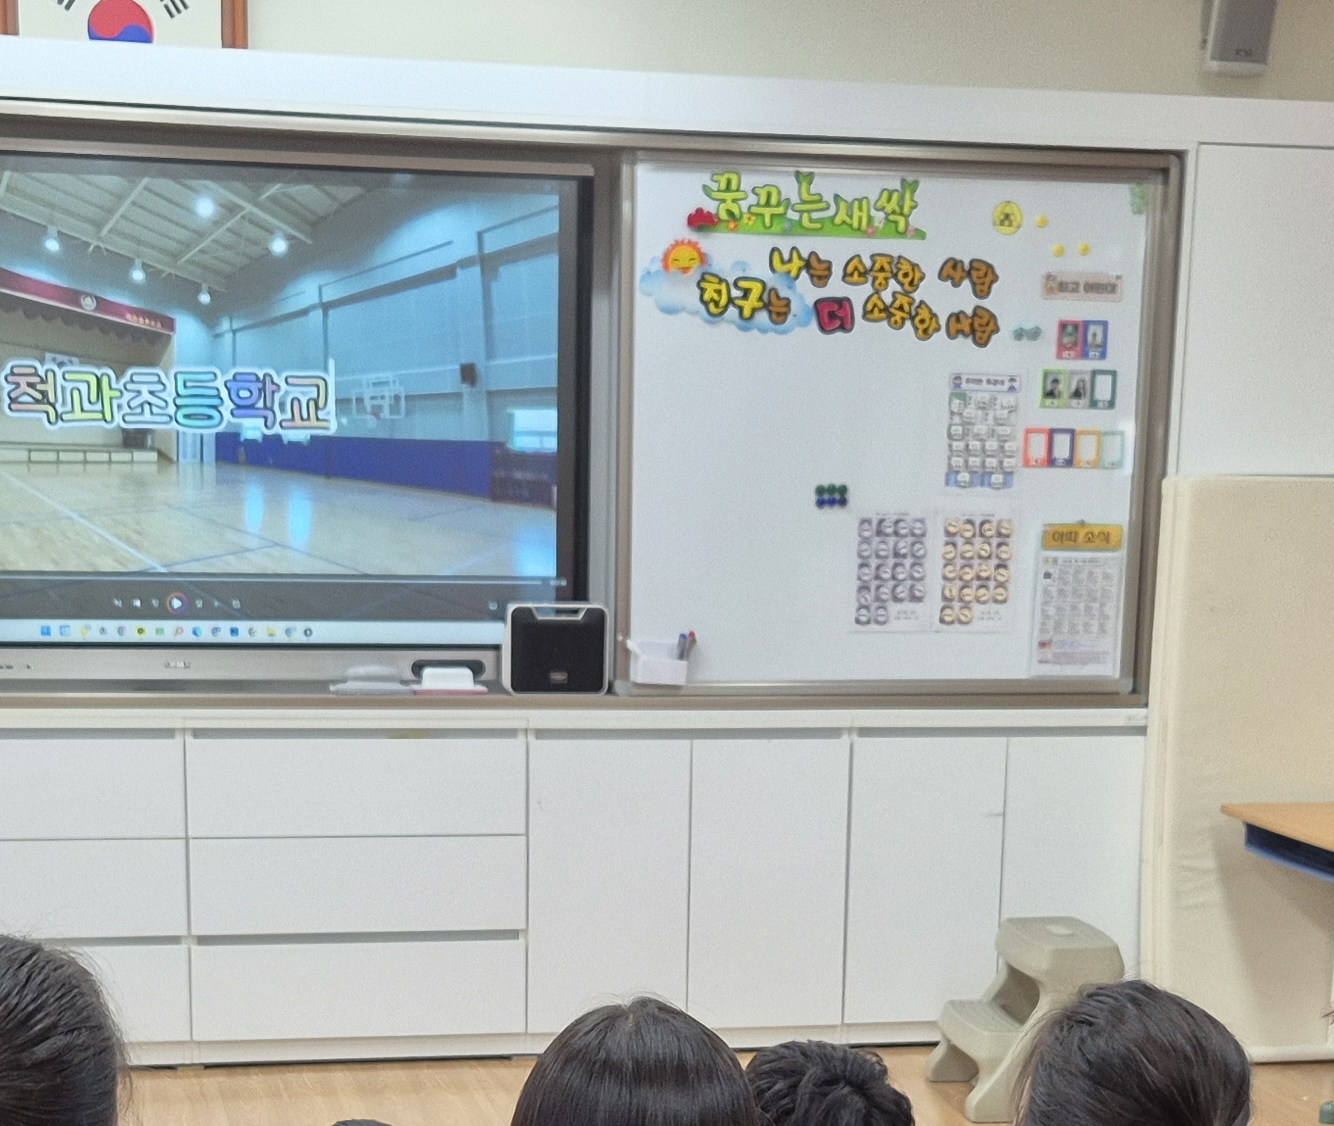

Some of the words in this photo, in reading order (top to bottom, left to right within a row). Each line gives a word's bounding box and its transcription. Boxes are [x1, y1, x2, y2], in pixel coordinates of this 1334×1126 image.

[703, 170, 830, 230] 꿈꾸는
[833, 178, 920, 234] 새싹
[769, 246, 833, 288] 나는
[842, 253, 925, 294] 소중한
[938, 257, 999, 300] 사람
[697, 272, 791, 325] 친구는
[814, 296, 855, 335] 더
[862, 291, 941, 341] 소중한
[3, 362, 334, 432] 척과초등학교
